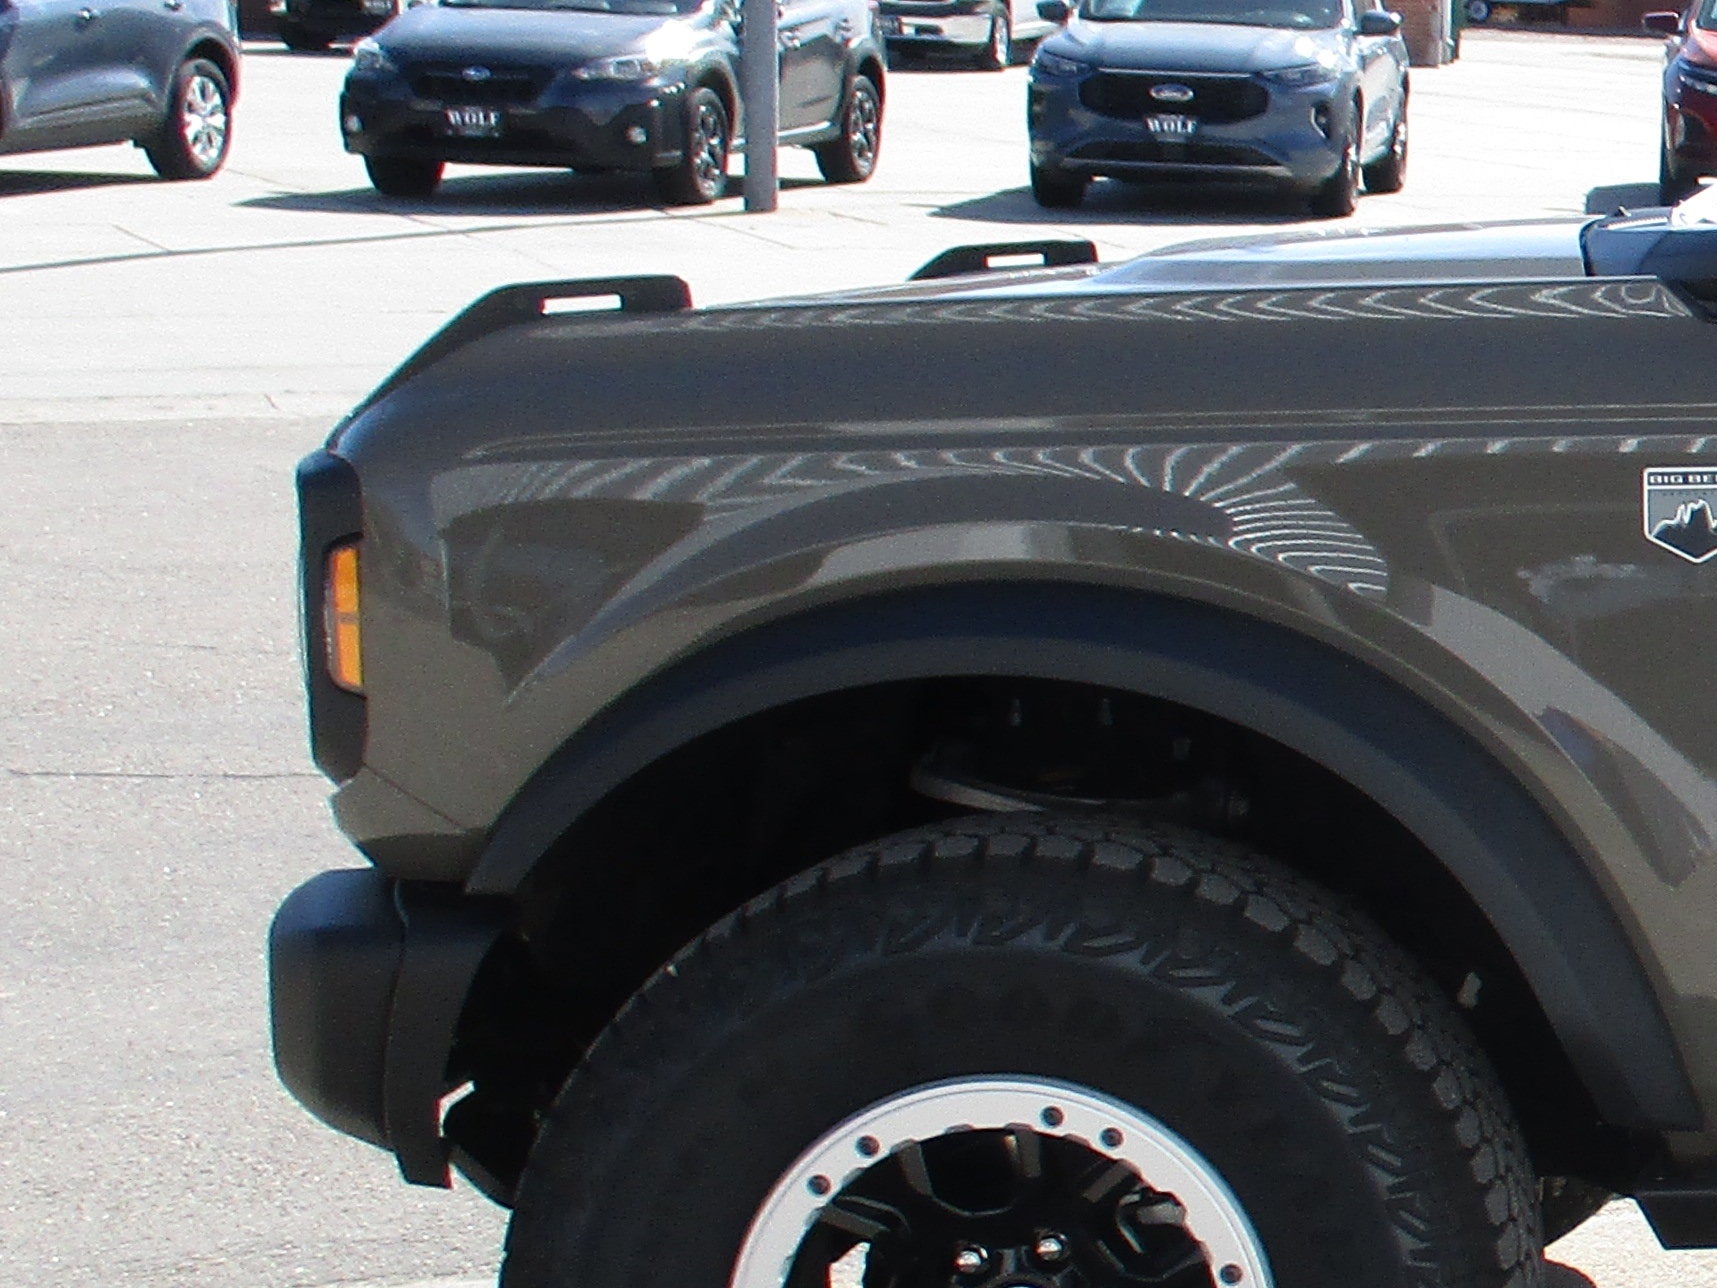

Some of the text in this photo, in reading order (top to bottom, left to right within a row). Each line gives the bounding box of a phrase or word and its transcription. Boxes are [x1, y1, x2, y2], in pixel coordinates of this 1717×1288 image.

[444, 110, 499, 126] WOLF
[1145, 118, 1197, 133] WOLF
[1649, 474, 1684, 485] BIG
